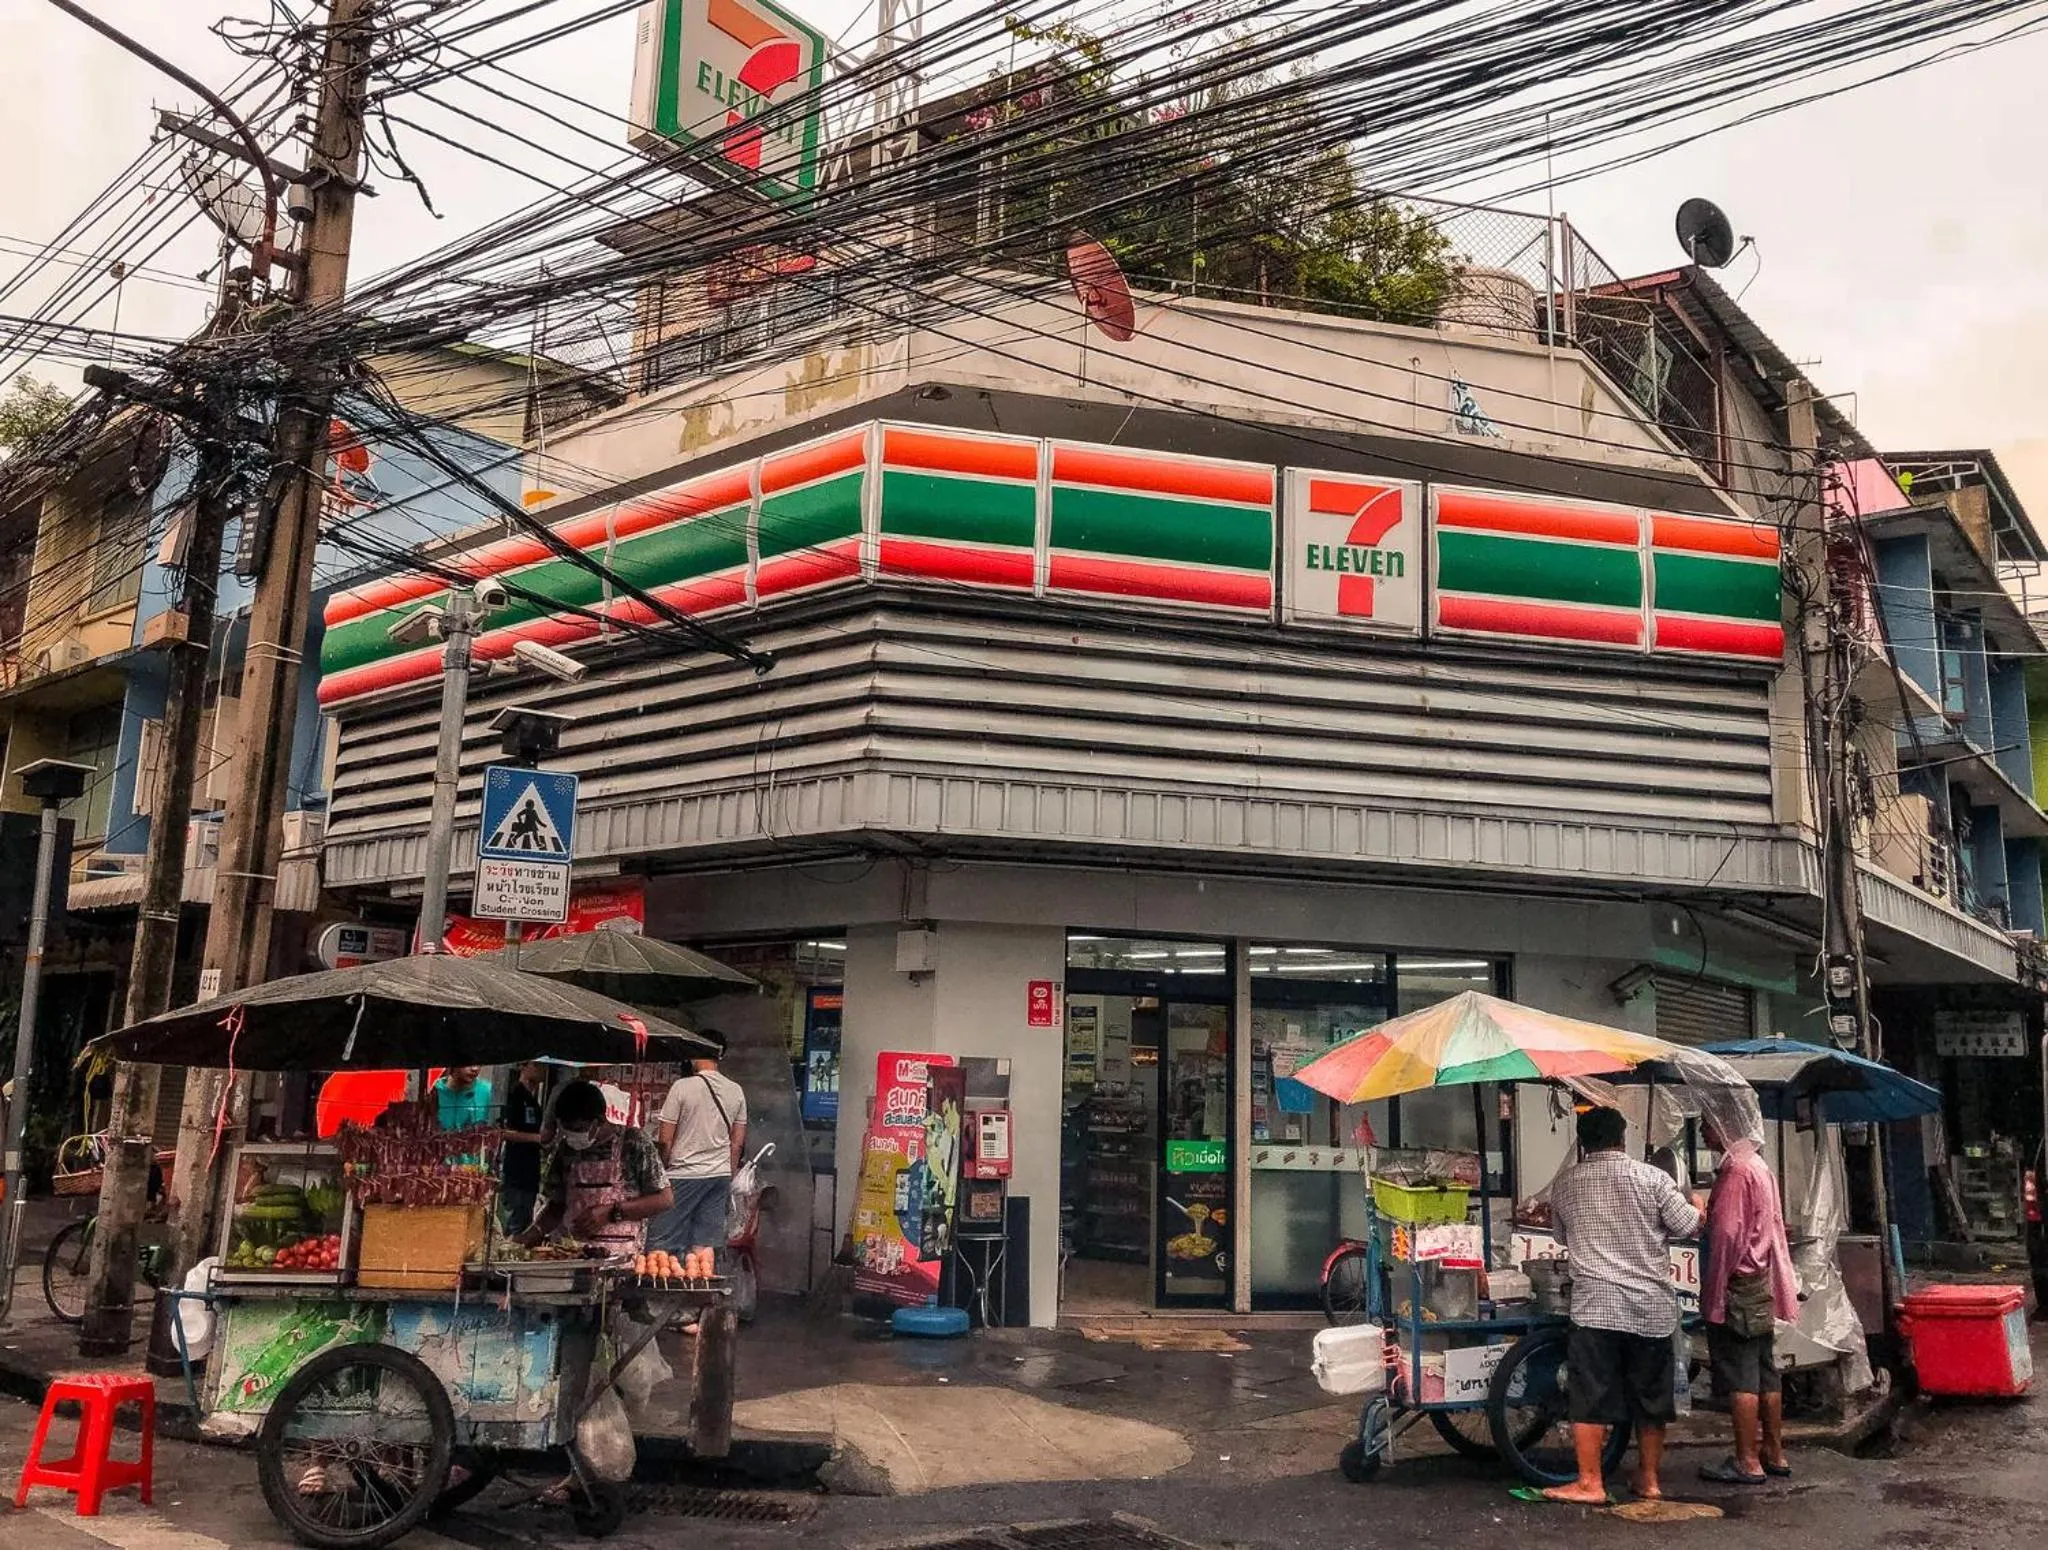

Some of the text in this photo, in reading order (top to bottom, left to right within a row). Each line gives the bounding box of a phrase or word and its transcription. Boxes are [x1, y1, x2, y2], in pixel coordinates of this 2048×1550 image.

[1310, 479, 1403, 618] 7
[486, 880, 559, 896] หน้าโรงเรียน
[481, 904, 561, 918] Student Crossing
